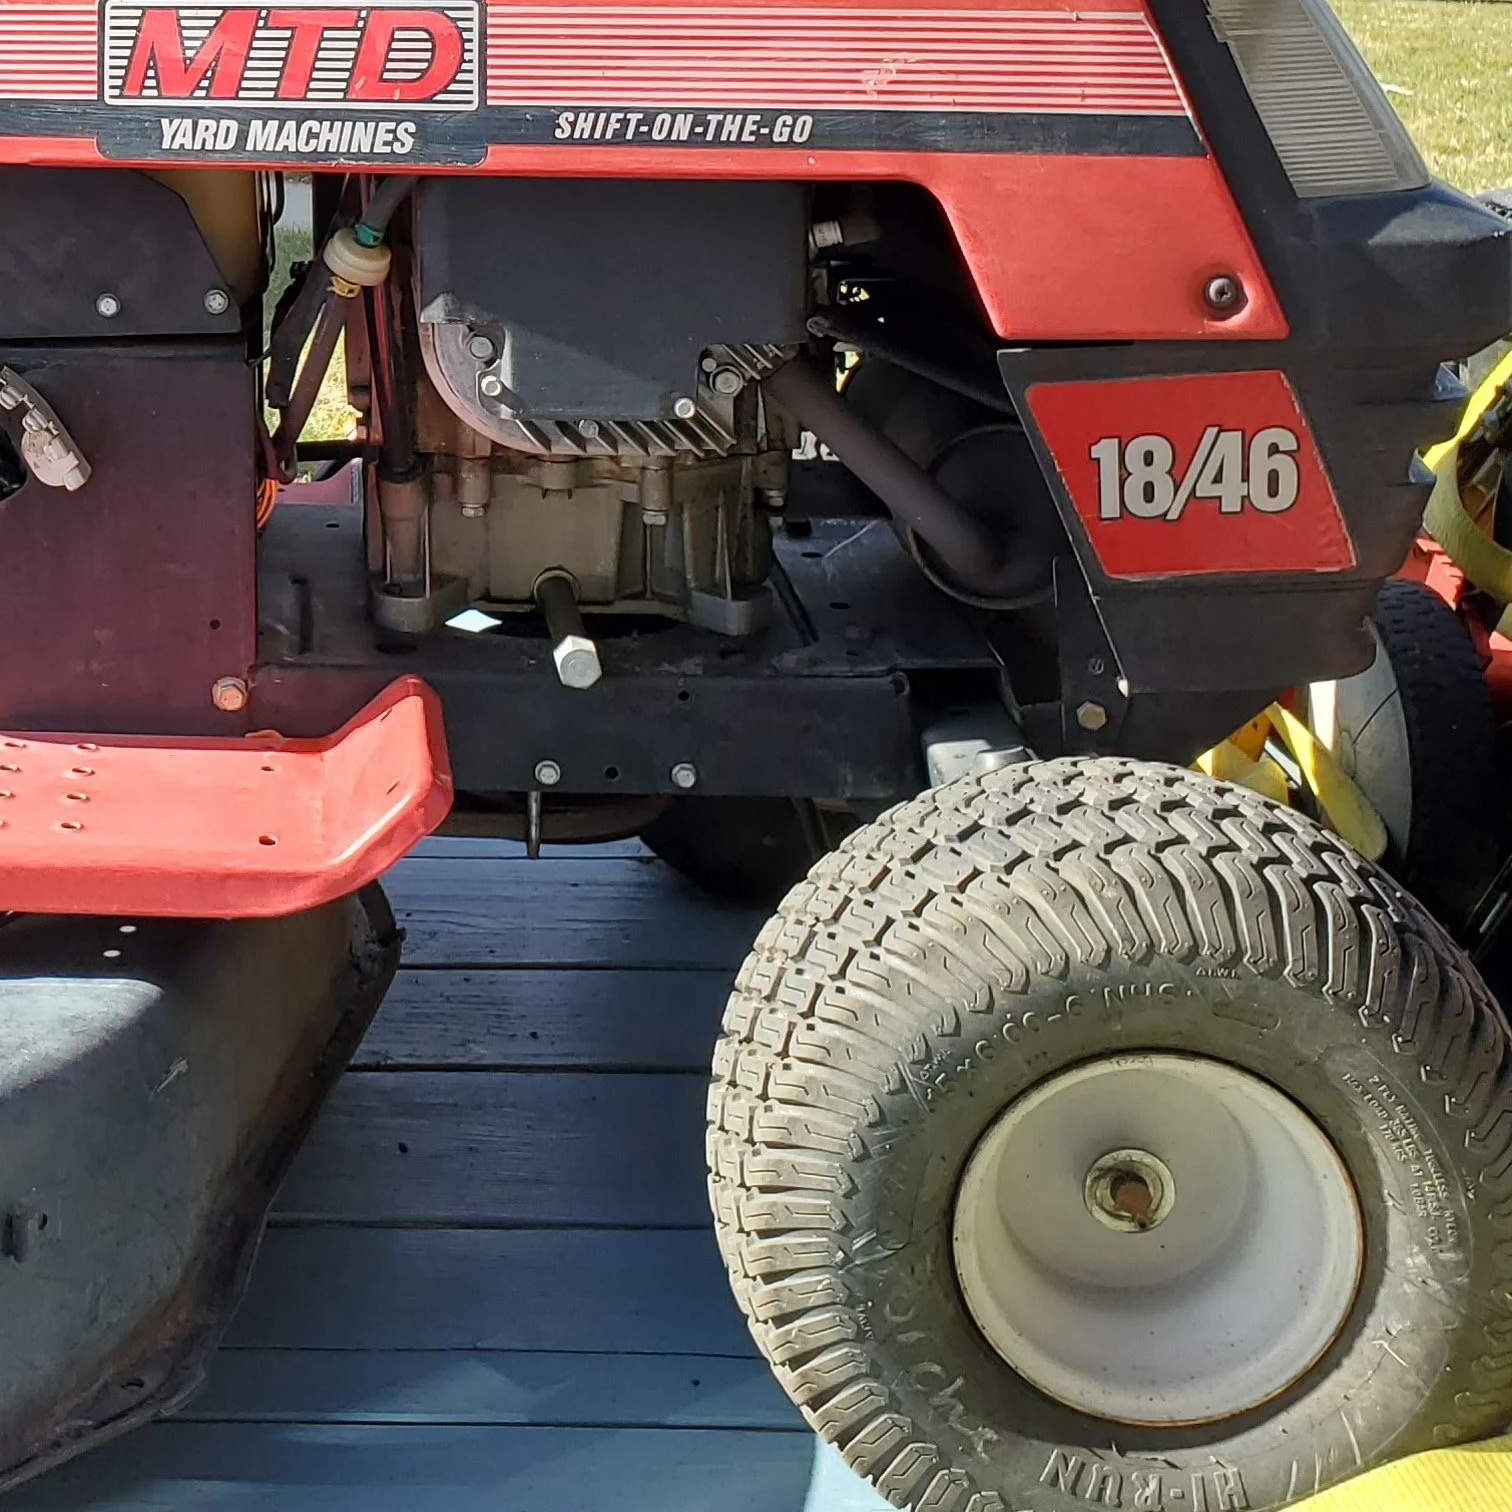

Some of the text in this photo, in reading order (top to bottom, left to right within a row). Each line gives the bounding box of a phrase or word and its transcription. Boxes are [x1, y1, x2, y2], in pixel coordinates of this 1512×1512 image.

[123, 8, 466, 101] MTD
[159, 118, 417, 156] YARD MACHINES
[554, 110, 815, 146] SHIFT-ON-THE-GO
[1088, 425, 1300, 522] 18/46
